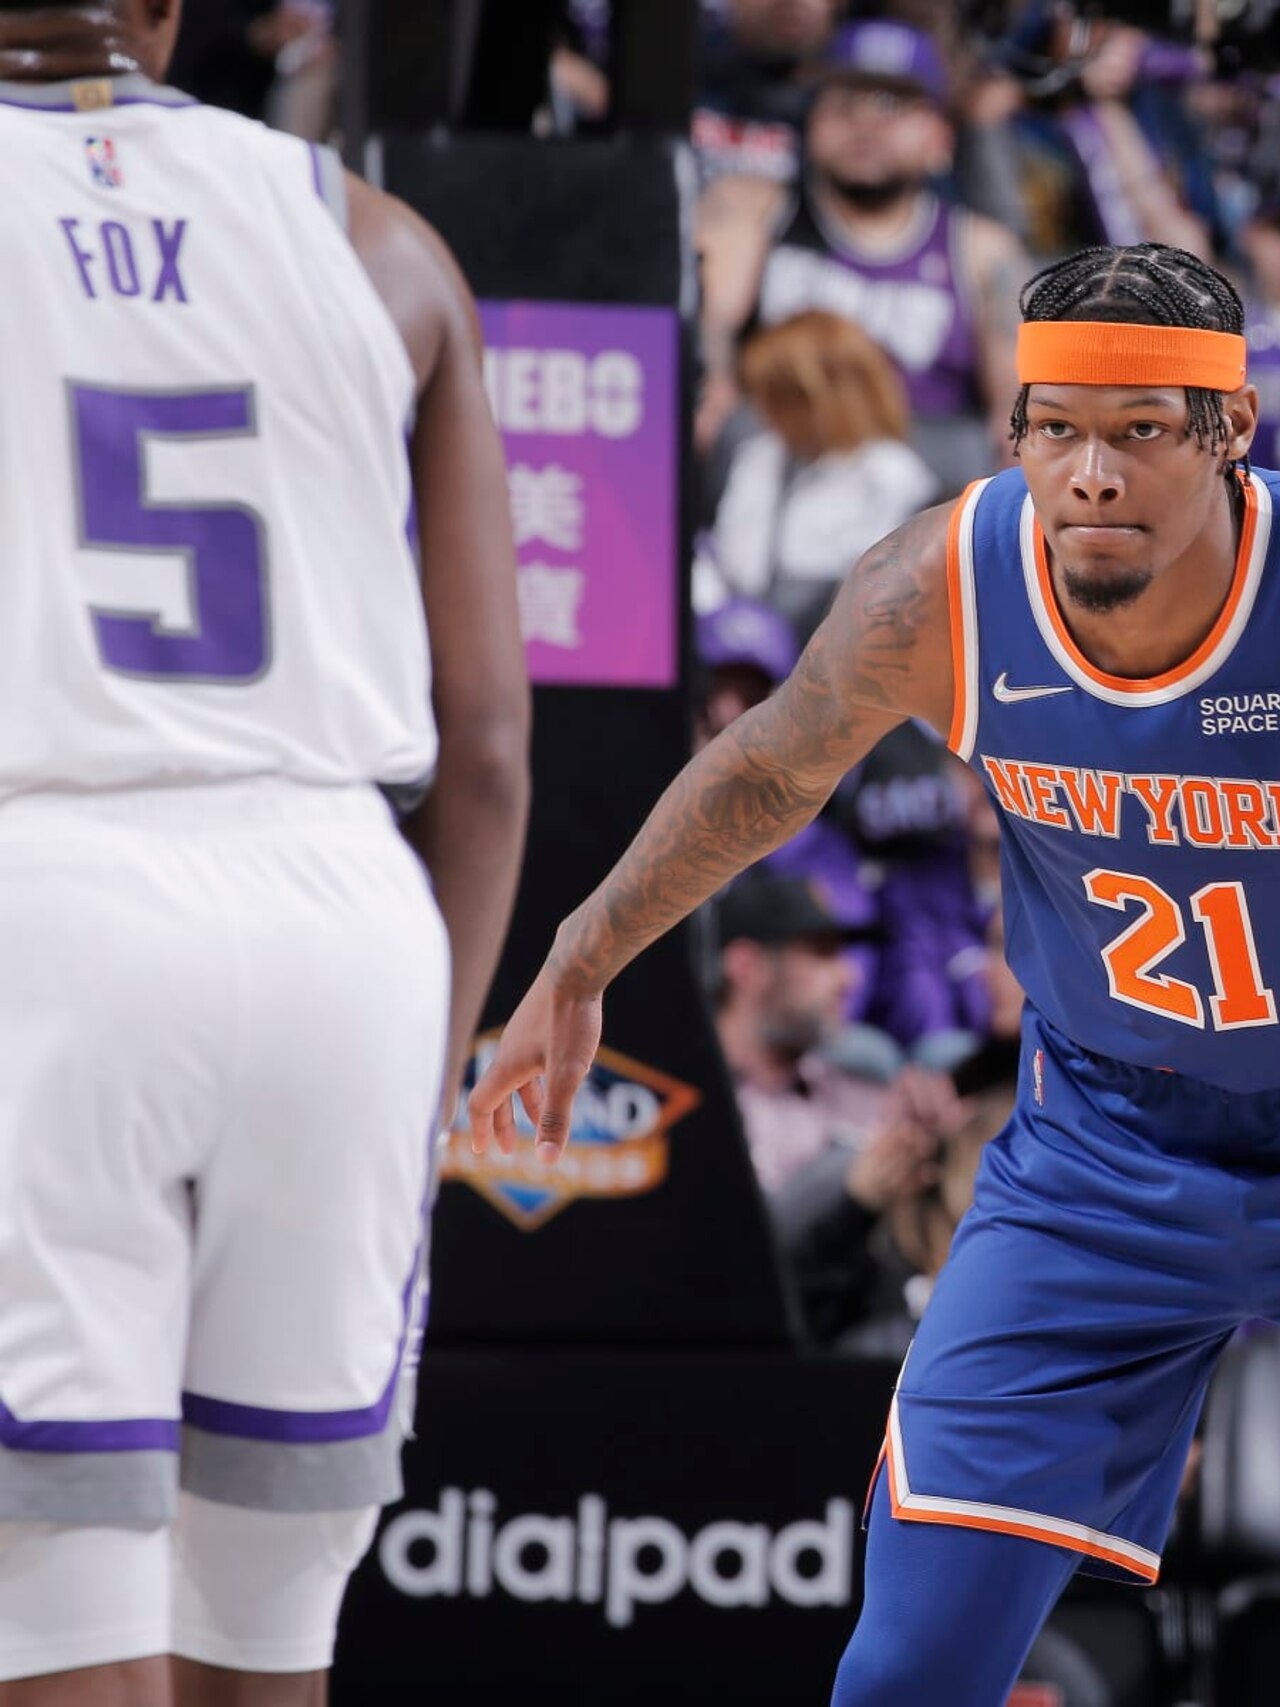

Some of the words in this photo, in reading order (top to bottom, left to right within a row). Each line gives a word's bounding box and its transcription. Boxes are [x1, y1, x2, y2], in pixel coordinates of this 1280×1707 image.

[58, 217, 189, 303] FOX
[62, 376, 274, 687] 5
[1201, 713, 1280, 736] SPACE
[980, 754, 1127, 841] NEW
[1080, 867, 1280, 1032] 21
[378, 1485, 856, 1629] dialpad
